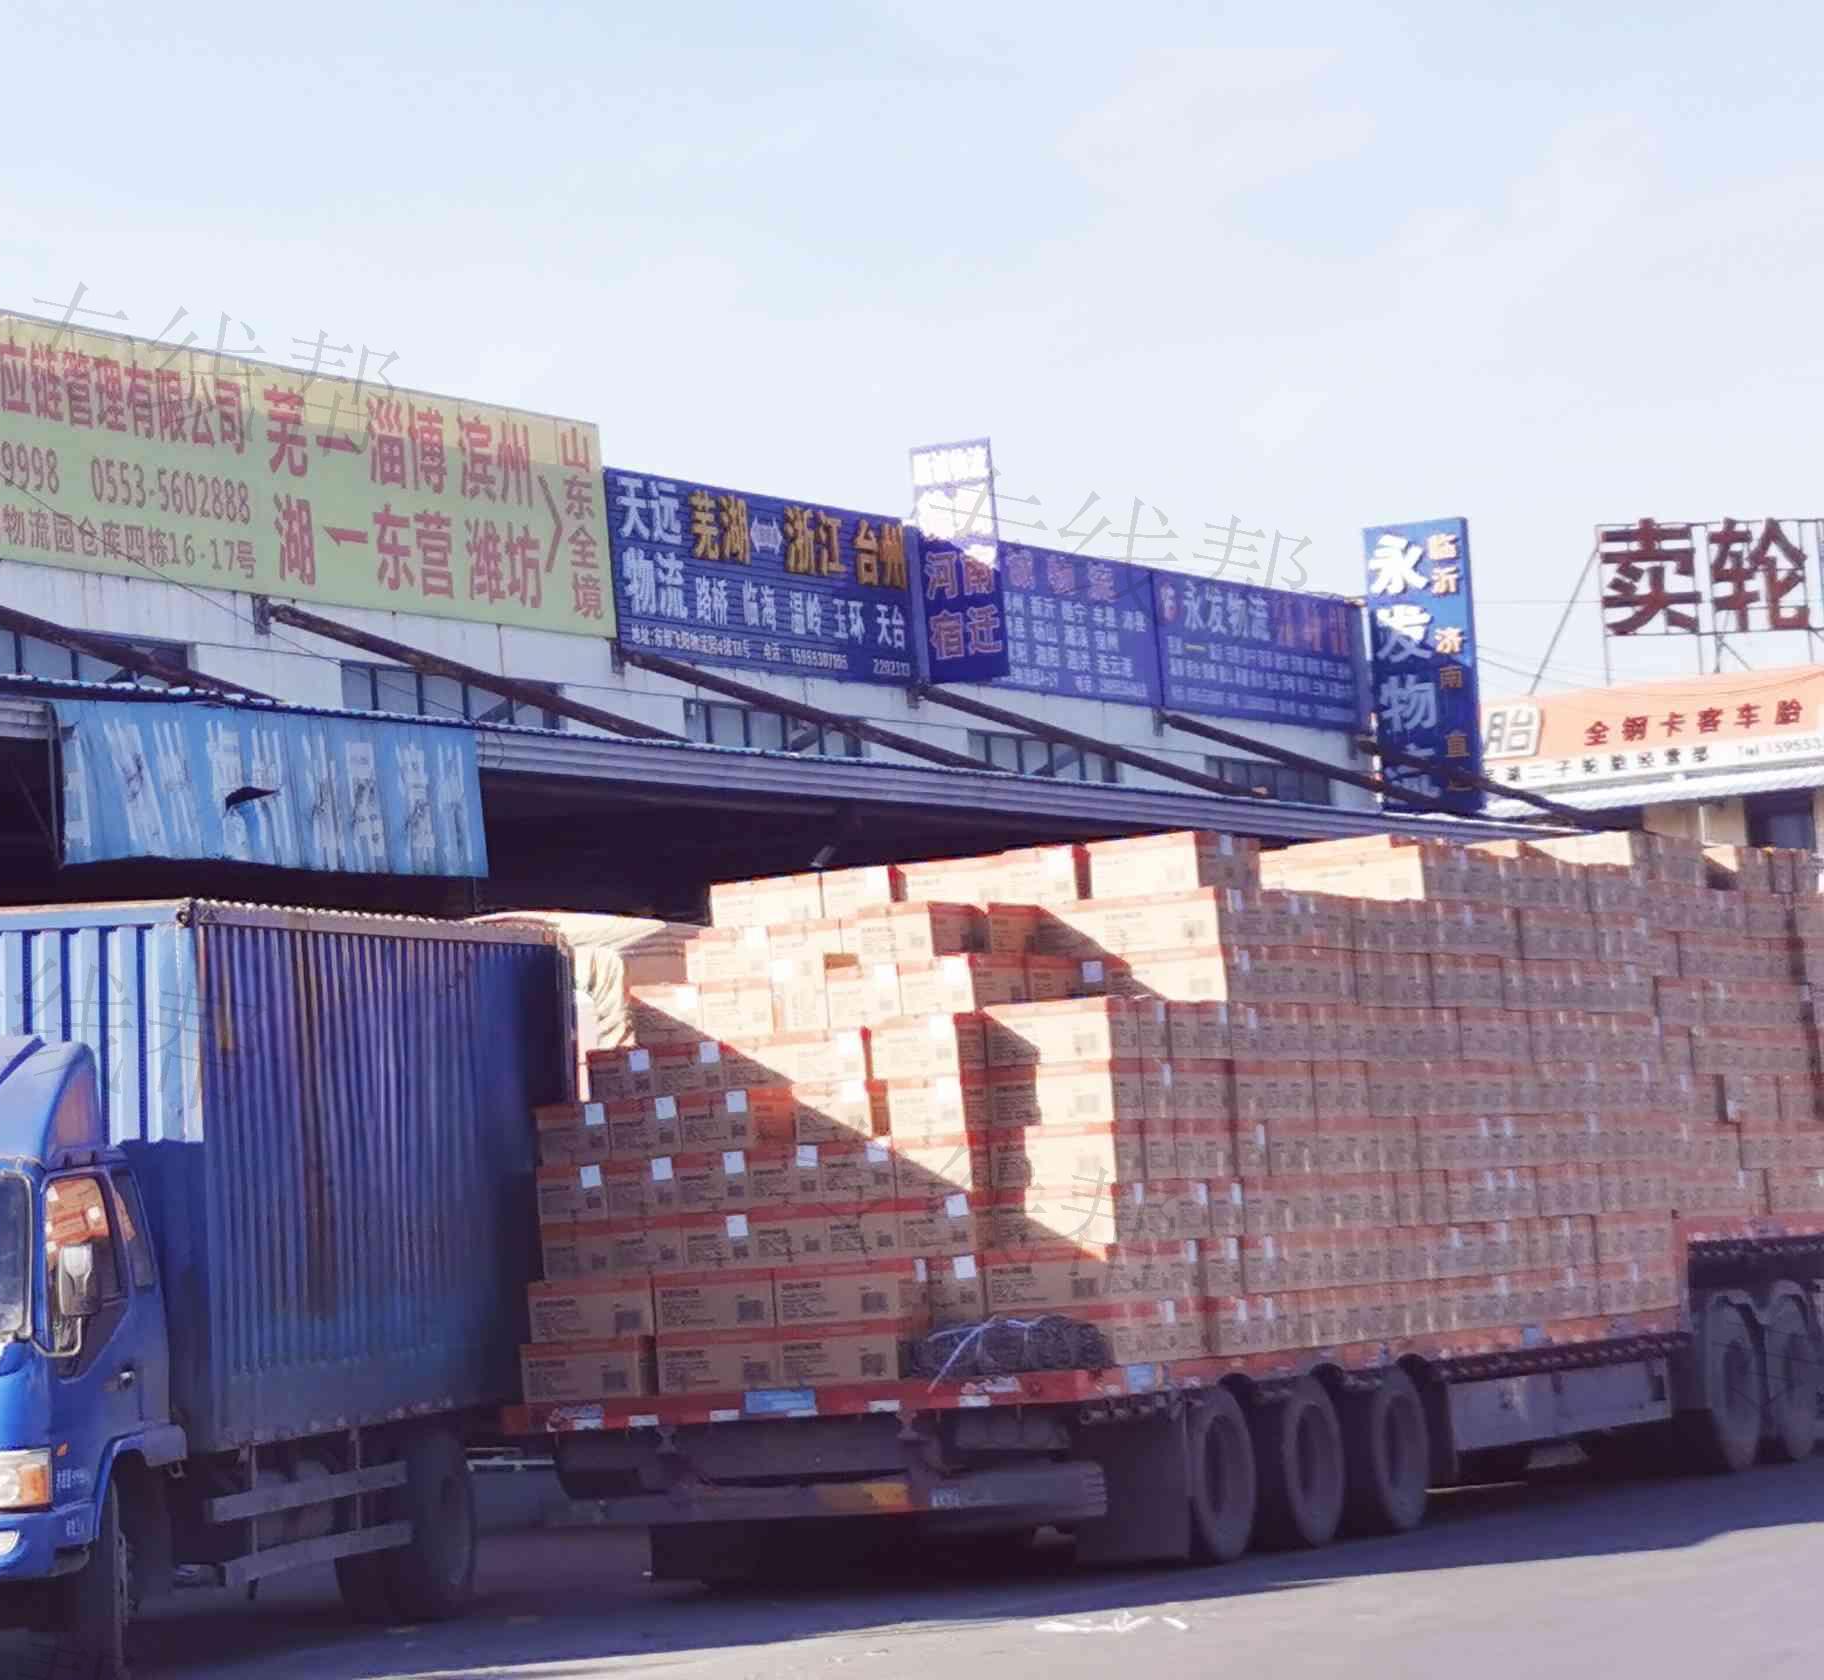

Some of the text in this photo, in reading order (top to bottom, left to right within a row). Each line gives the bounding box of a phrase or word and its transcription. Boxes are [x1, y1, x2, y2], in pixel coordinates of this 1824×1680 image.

[366, 395, 534, 508] 淄博 滨州
[90, 457, 253, 525] 0553-5602888
[560, 427, 605, 621] 山东全境
[615, 475, 683, 545] 天远
[372, 503, 542, 609] 东营 潍坊
[688, 489, 753, 566] 芜湖
[783, 505, 849, 577] 浙江
[853, 518, 908, 592] 台州
[1427, 533, 1460, 597] 临沂
[622, 546, 689, 620] 物流
[1183, 579, 1271, 642] 永发物流
[1600, 517, 1812, 637] 卖轮
[742, 577, 777, 631] 临海
[789, 589, 823, 638] 温岭
[832, 597, 866, 645] 玉环
[876, 603, 906, 650] 天台
[929, 603, 1003, 661] 宿迁
[1485, 707, 1535, 755] 胎
[1584, 699, 1803, 747] 全钢卡客车胎
